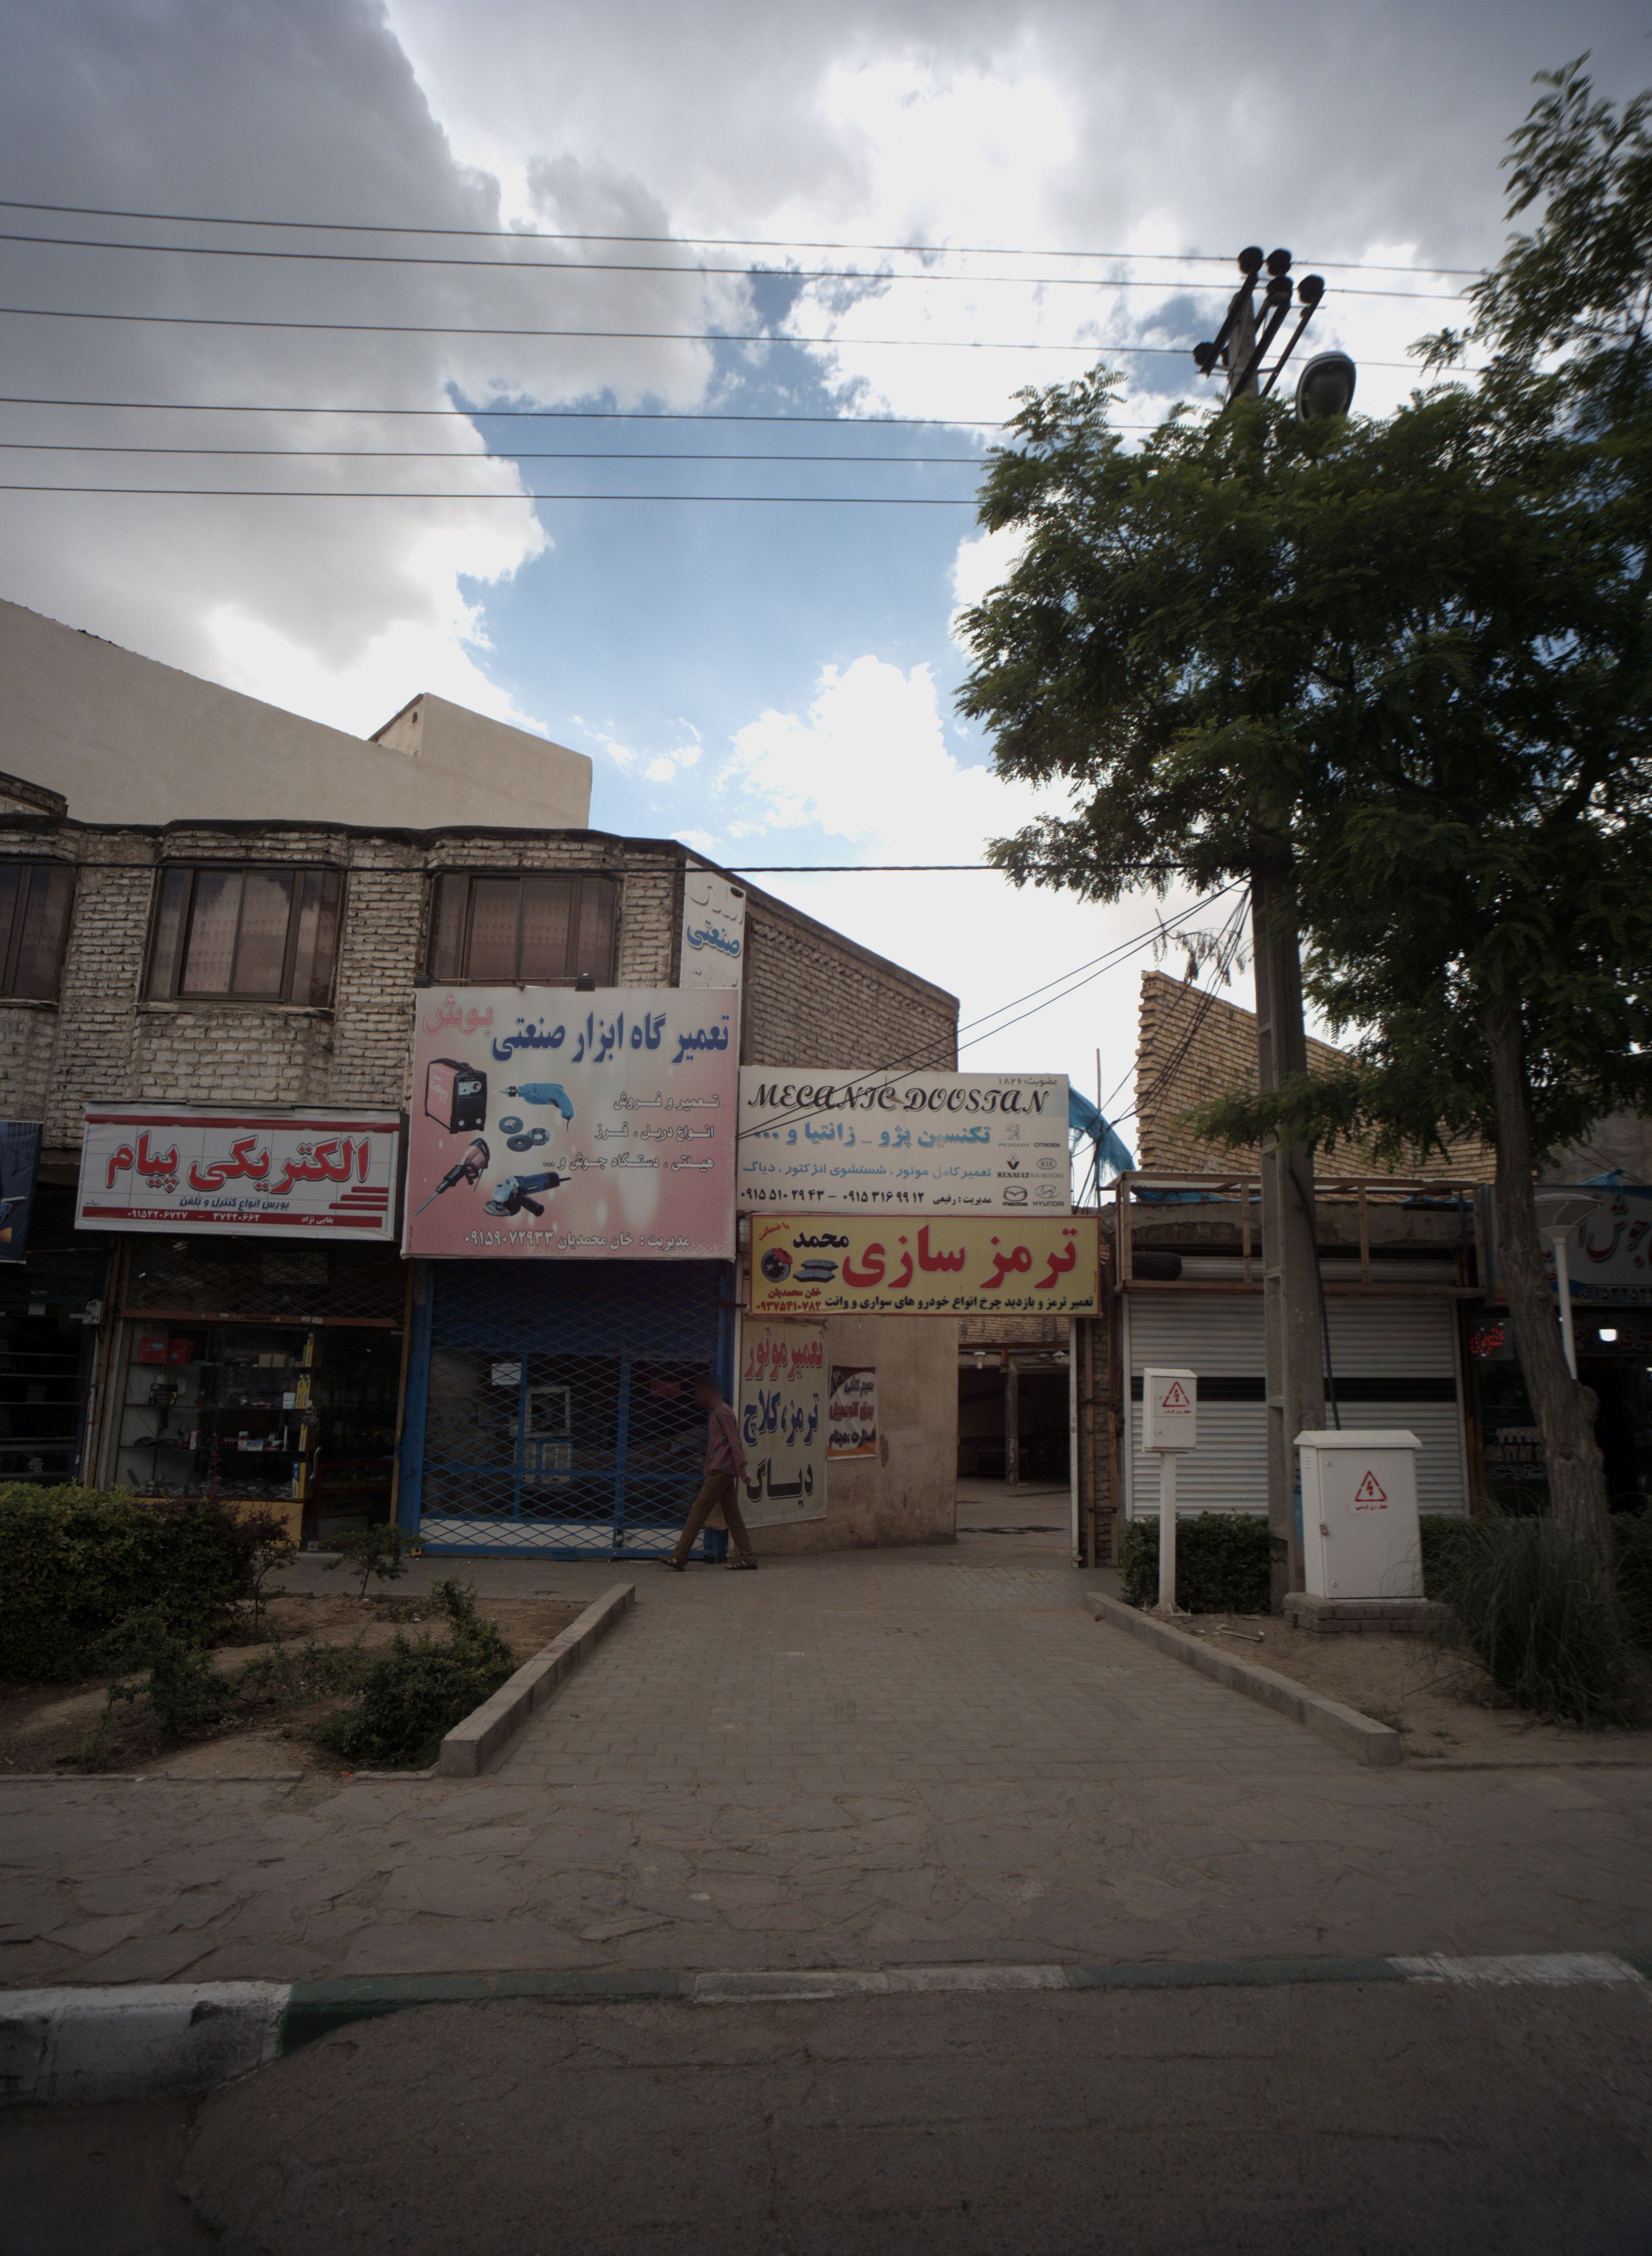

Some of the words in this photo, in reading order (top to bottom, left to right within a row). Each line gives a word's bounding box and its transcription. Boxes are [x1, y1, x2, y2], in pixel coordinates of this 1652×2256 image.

[687, 920, 742, 957] صنعتی
[423, 992, 494, 1038] بوش
[569, 1010, 625, 1064] ابزار
[629, 1010, 667, 1051] گاه
[670, 1013, 731, 1065] تعمیر
[490, 1016, 567, 1063] صنعتی
[613, 1092, 663, 1110] فروش
[665, 1098, 673, 1110] و
[676, 1094, 720, 1110] تعمیر
[748, 1083, 899, 1111] MECANIC
[903, 1087, 1050, 1115] DOOSTAN
[595, 1121, 629, 1140] فرز
[640, 1124, 673, 1142] دریل
[676, 1124, 714, 1141] انواع
[785, 1129, 797, 1146] و
[805, 1122, 856, 1147] زانتیا
[878, 1125, 911, 1149] پژو
[917, 1126, 992, 1148] تکنسین
[105, 1130, 180, 1194] پیام
[187, 1135, 371, 1195] الکتریکی
[557, 1157, 567, 1170] و
[569, 1152, 608, 1170] جوش
[611, 1152, 660, 1168] دستگاه
[671, 1156, 714, 1172] هیلتی
[743, 1161, 776, 1175] دیاگ
[785, 1163, 827, 1177] انژکتور
[830, 1164, 887, 1178] شستشوی
[896, 1167, 929, 1180] موتور
[932, 1166, 960, 1179] کامل
[960, 1168, 992, 1180] تعمیر
[180, 1197, 201, 1207] تلفن
[211, 1197, 236, 1207] کنترل
[238, 1199, 260, 1210] انواع
[262, 1201, 290, 1211] بورس
[933, 1194, 956, 1205] رفیعی
[301, 1216, 315, 1224] نژاد
[464, 1229, 555, 1246] ۰۹۱۵۹۰۷۲۹۳۳
[758, 1223, 781, 1241] ضمانت
[793, 1232, 850, 1248] محمد
[557, 1232, 607, 1250] محمدیان
[610, 1232, 633, 1250] خان
[842, 1224, 965, 1289] سازی
[979, 1227, 1078, 1289] ترمز
[768, 1288, 803, 1299] محمدیان
[805, 1288, 822, 1299] خان
[894, 1295, 915, 1309] های
[825, 1296, 849, 1309] وانت
[852, 1300, 857, 1309] و
[860, 1296, 892, 1310] سواری
[917, 1296, 949, 1310] خودرو
[952, 1296, 977, 1310] انواع
[980, 1297, 1002, 1309] چرخ
[1004, 1296, 1035, 1309] بازدید
[1038, 1300, 1043, 1310] و
[1046, 1297, 1067, 1310] ترمز
[1069, 1296, 1094, 1310] تعمیر
[744, 1326, 787, 1381] موتور
[786, 1330, 824, 1380] تعمیر
[844, 1376, 861, 1395] کشی
[860, 1381, 874, 1398] سیم
[743, 1388, 781, 1446] کلاچ
[829, 1401, 859, 1422] اتومبیل
[859, 1401, 874, 1421] برق
[746, 1457, 814, 1508] دیاگ
